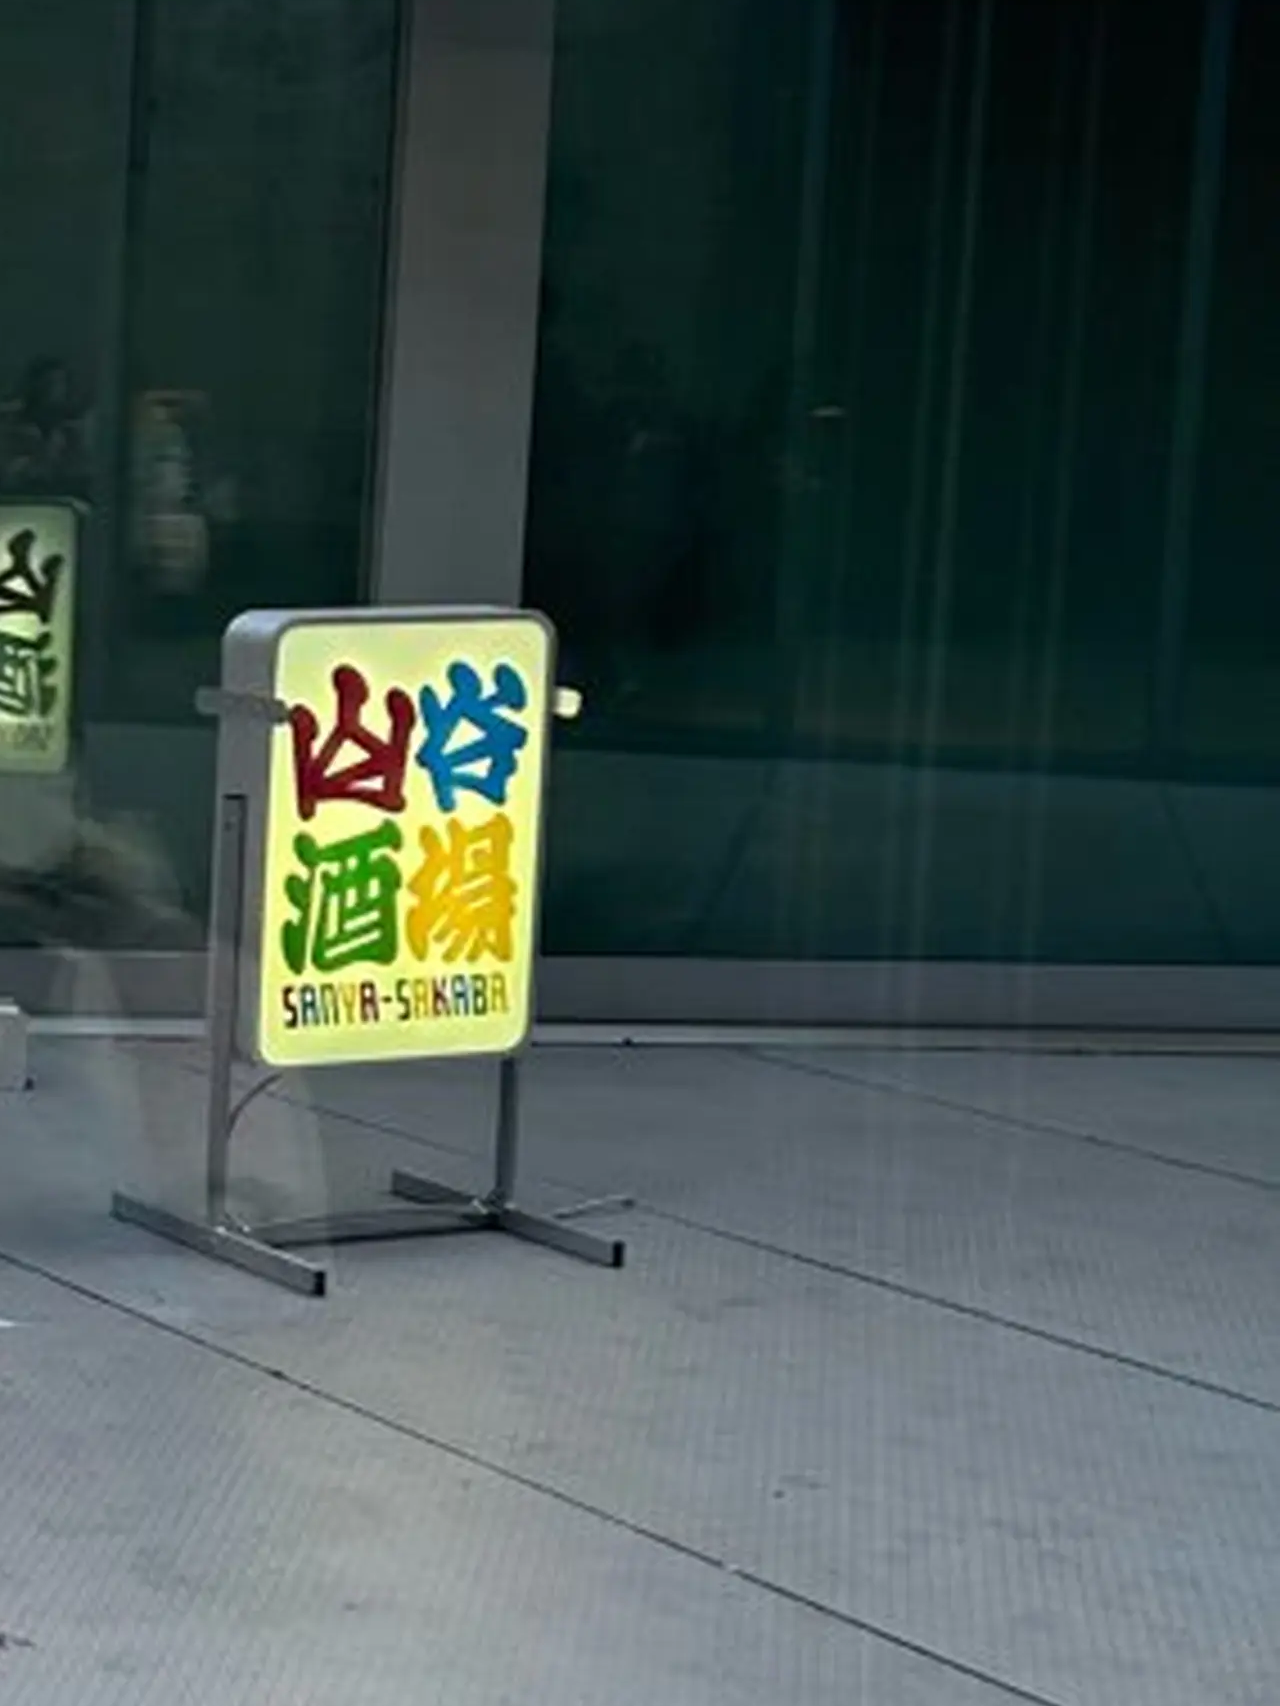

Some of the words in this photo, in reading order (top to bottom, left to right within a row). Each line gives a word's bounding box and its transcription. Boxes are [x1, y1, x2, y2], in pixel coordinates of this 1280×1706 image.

[291, 663, 528, 821] 山谷
[282, 813, 516, 975] 酒場
[281, 972, 510, 1029] SANYA-SAKABA
